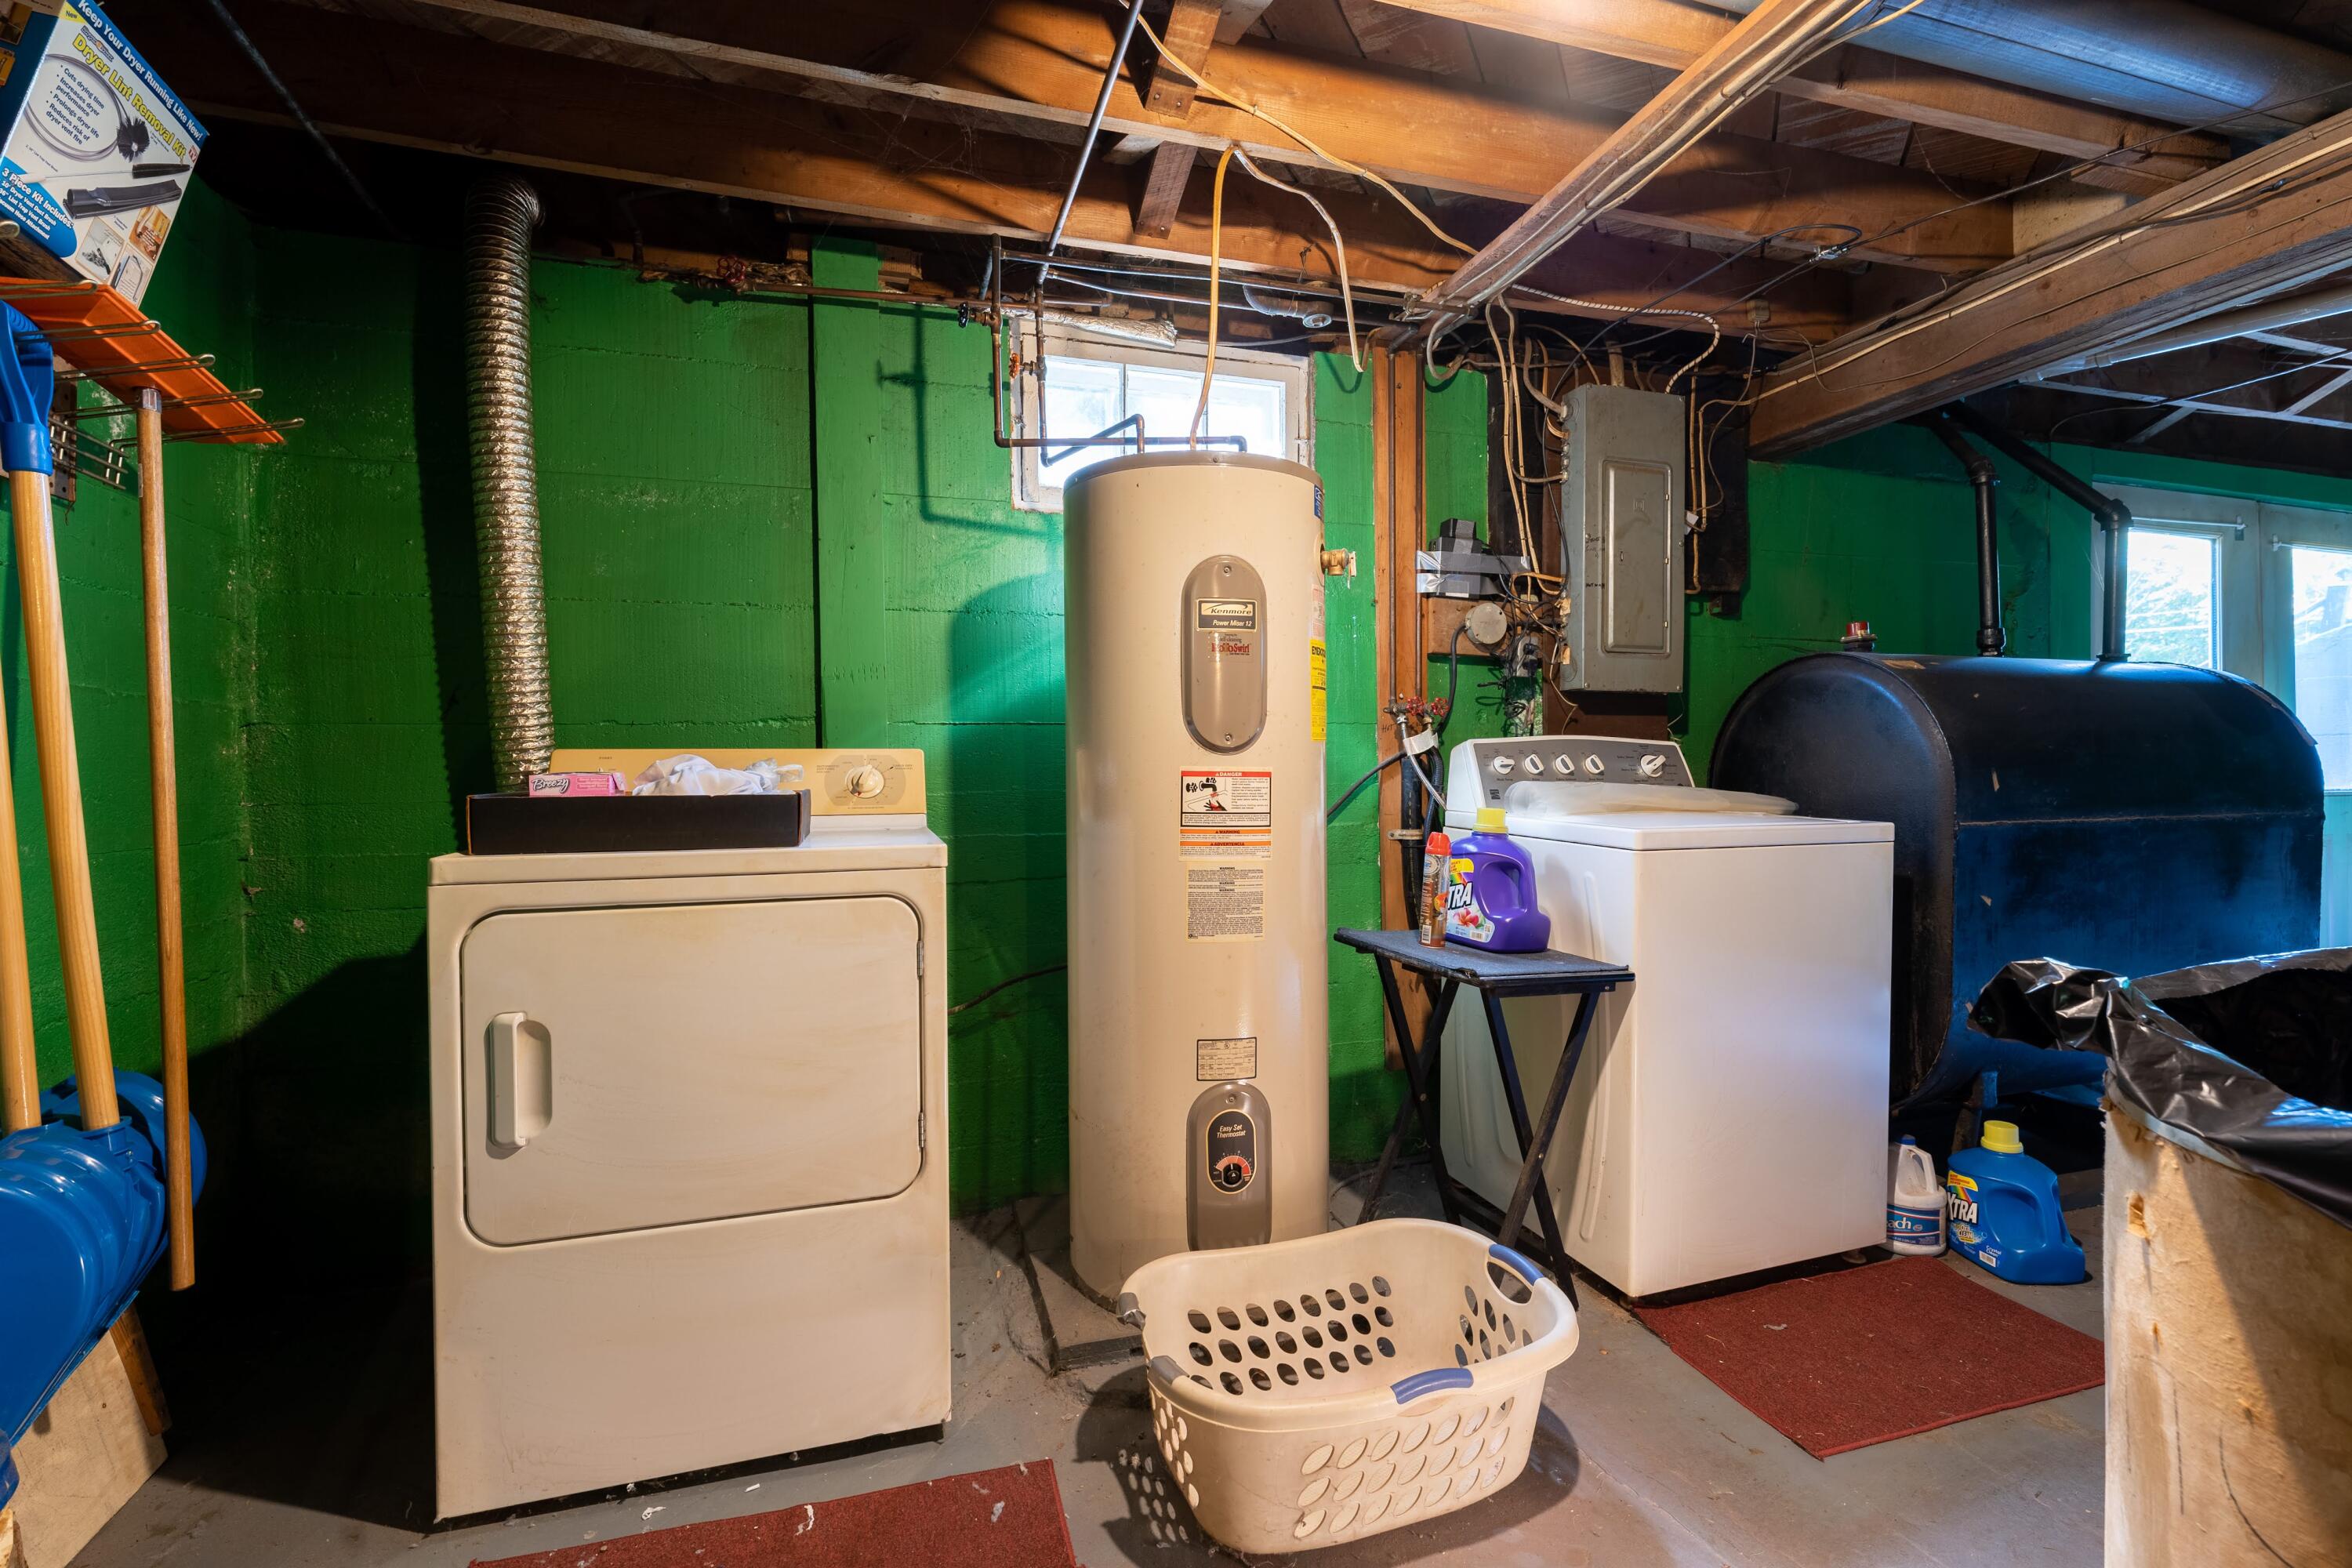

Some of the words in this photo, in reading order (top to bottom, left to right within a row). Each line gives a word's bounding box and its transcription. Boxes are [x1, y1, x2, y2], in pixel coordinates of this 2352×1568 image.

[64, 67, 77, 82] Cuts
[77, 81, 94, 100] drying
[93, 96, 105, 110] time
[78, 0, 103, 28] Keep
[103, 24, 123, 49] Your
[122, 47, 146, 74] Dryer
[144, 71, 175, 109] Running
[172, 103, 187, 124] Like
[186, 120, 204, 141] New!
[56, 85, 90, 117] performance
[60, 77, 86, 104] Increases
[86, 102, 100, 117] dryer
[73, 33, 111, 76] Dryer
[108, 70, 133, 101] Lint
[132, 93, 176, 146] Removal
[172, 137, 187, 158] Kit
[45, 111, 62, 125] dryer
[61, 123, 73, 136] vent
[72, 134, 83, 145] fire
[49, 103, 72, 126] Reduces
[72, 125, 83, 136] risk
[53, 93, 77, 118] Prolongs
[77, 116, 91, 130] dryer
[90, 127, 100, 139] life
[2, 168, 9, 177] 3
[9, 173, 32, 195] Piece
[31, 191, 44, 204] Kit
[43, 200, 74, 229] Includes:
[8, 195, 18, 205] Lint
[17, 201, 28, 214] Trap
[27, 209, 38, 222] Vent
[38, 219, 51, 231] Brush
[10, 187, 24, 199] Dryer
[24, 197, 34, 209] Vent
[34, 205, 45, 216] Duct
[43, 212, 56, 226] Brush
[0, 198, 15, 213] acuum
[14, 210, 27, 222] Hose
[25, 220, 50, 240] Attachment
[532, 778, 570, 793] Breezy
[1447, 881, 1473, 910] TRA
[1887, 1217, 1911, 1229] ach
[1947, 1192, 1979, 1224] XTRA
